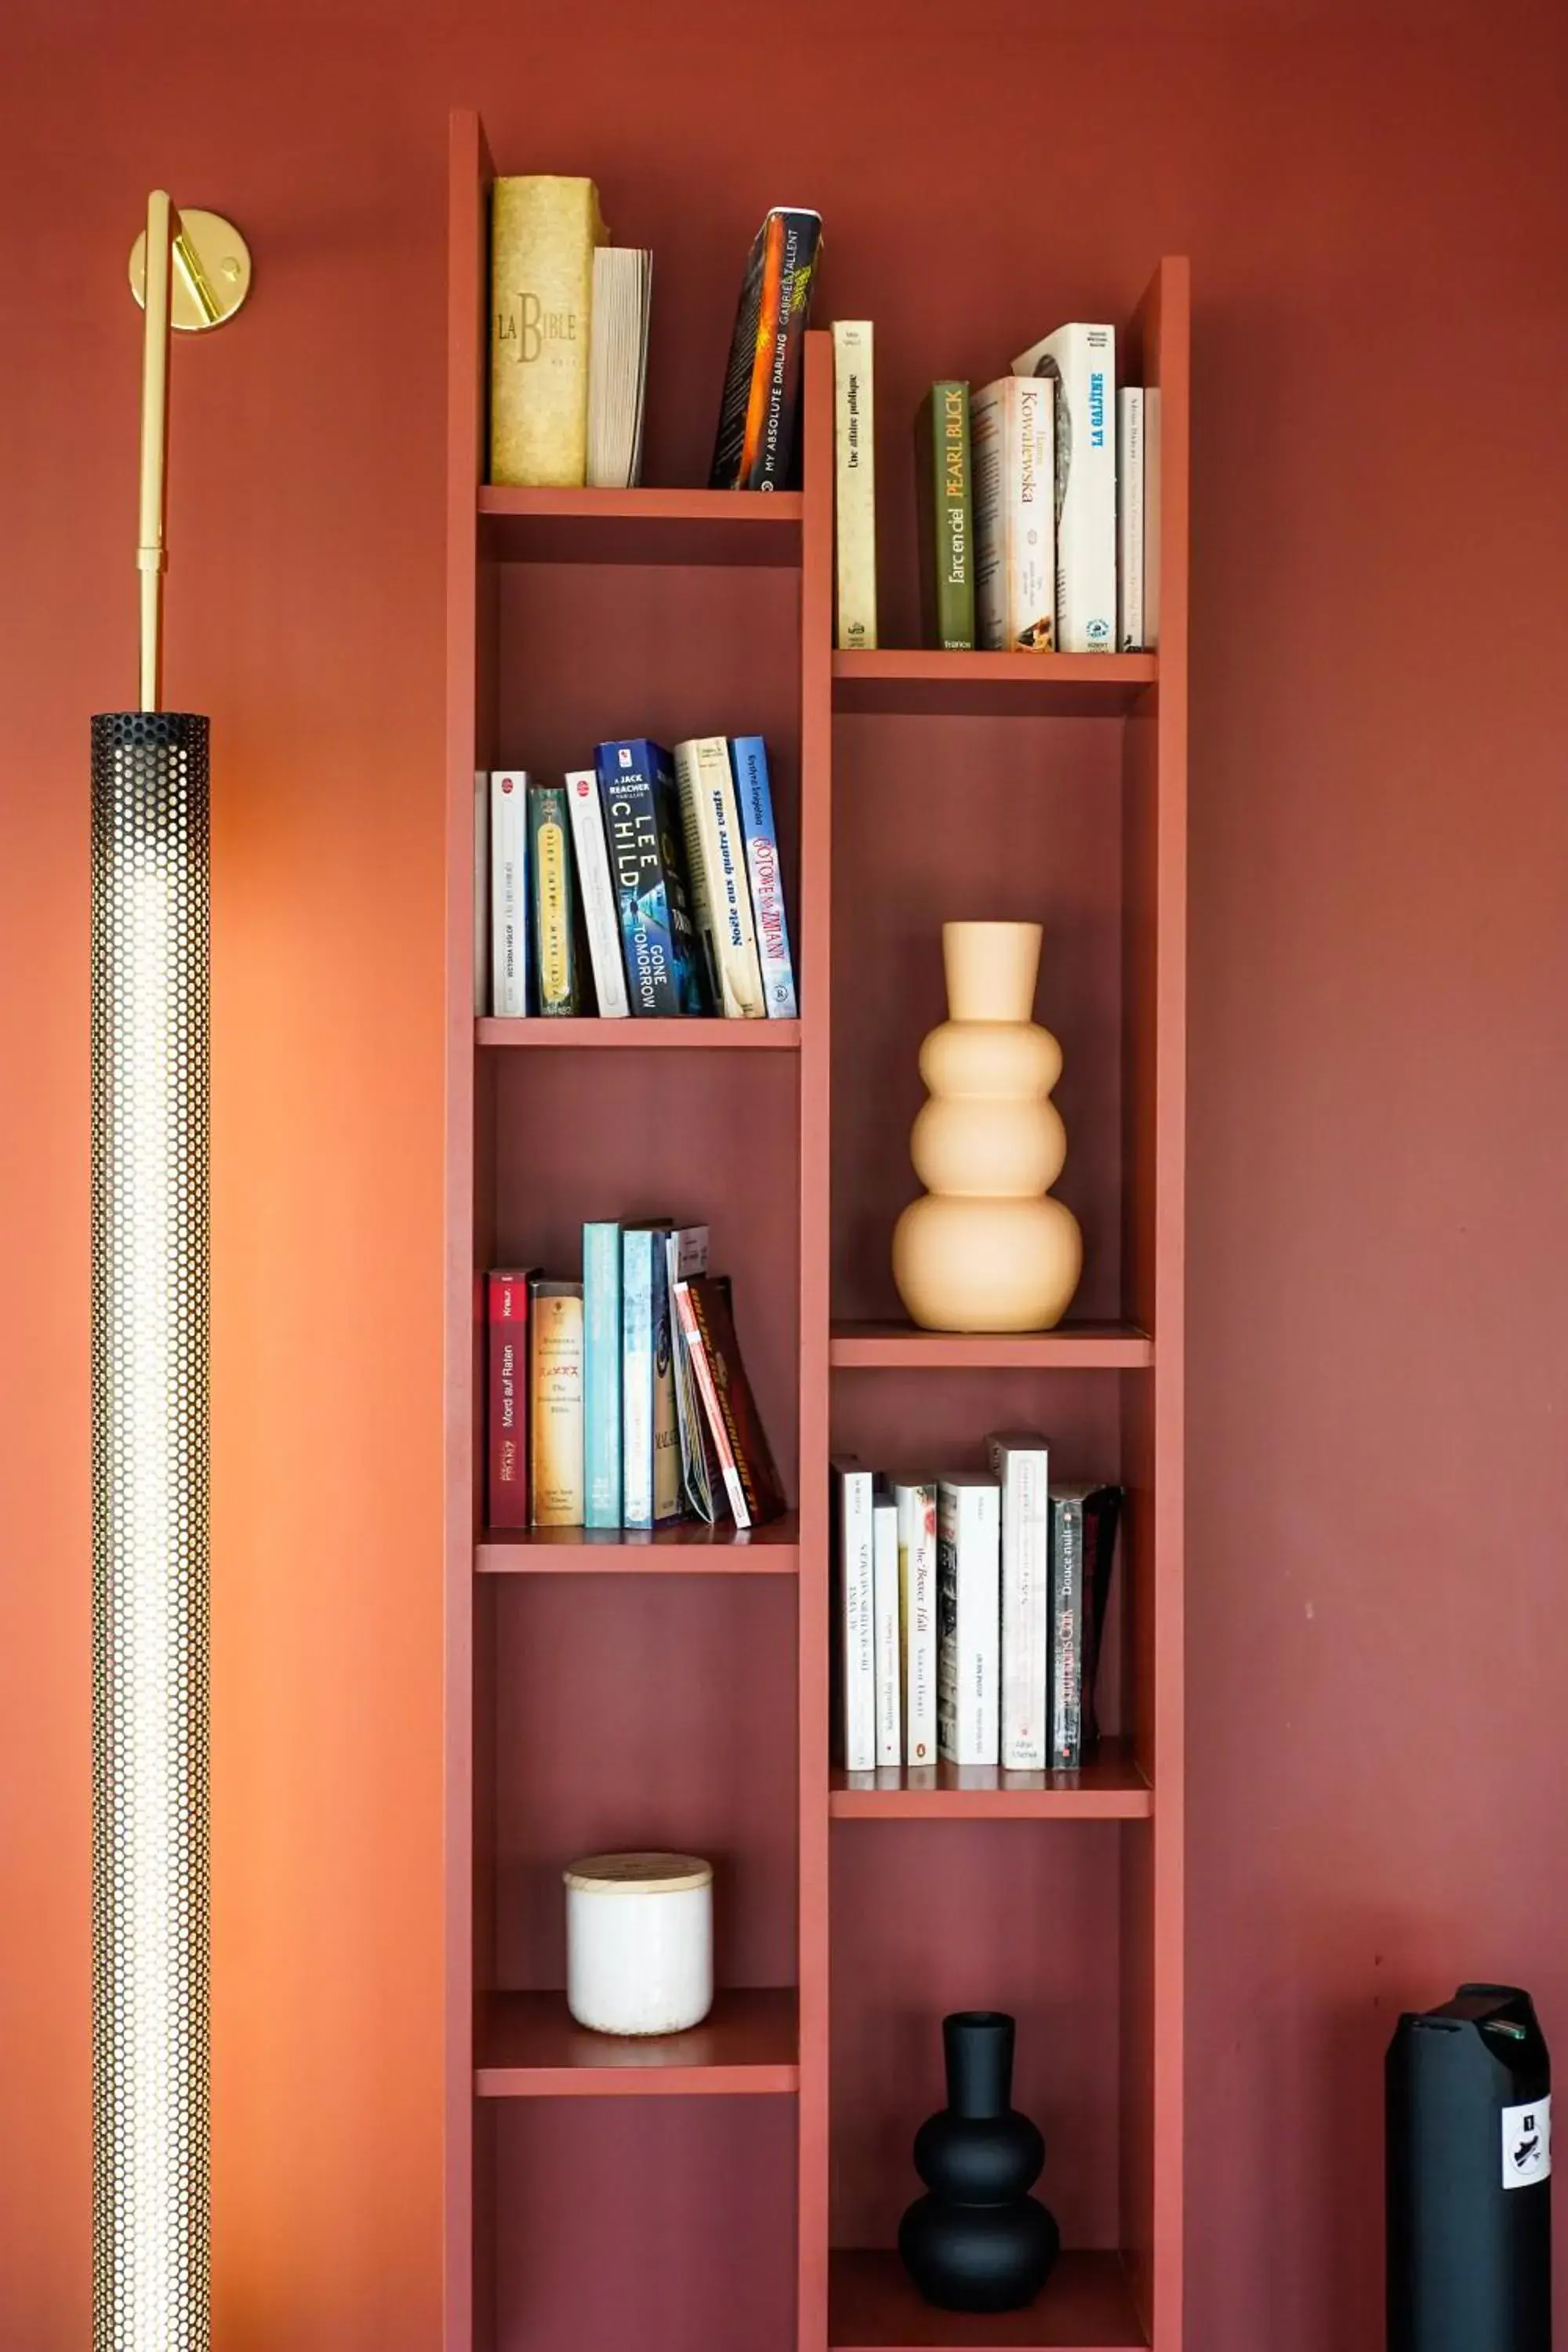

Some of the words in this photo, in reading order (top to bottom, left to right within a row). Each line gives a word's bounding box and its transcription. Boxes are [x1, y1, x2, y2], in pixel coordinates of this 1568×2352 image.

[784, 229, 798, 275] TALLENT
[779, 277, 793, 325] GABRIEL
[499, 313, 517, 339] LA
[517, 292, 577, 364] BIBLE
[773, 334, 787, 383] DARLING
[848, 374, 859, 415] publique
[946, 390, 963, 438] BUCK
[767, 388, 782, 451] ABSOLUTE
[848, 418, 858, 448] affaire
[1091, 430, 1103, 448] LA
[765, 454, 775, 471] MY
[848, 451, 858, 468] Une
[1022, 391, 1037, 503] Kowalewska
[946, 442, 964, 498] PEARL
[948, 508, 964, 532] ciel
[952, 533, 964, 552] en
[609, 783, 650, 794] REACHER
[620, 774, 644, 783] JACK
[713, 789, 724, 826] vents
[612, 802, 640, 887] CHILD
[635, 815, 658, 868] LEE
[719, 831, 734, 874] quatre
[753, 836, 775, 895] GOTOWE
[726, 879, 736, 904] aux
[761, 909, 785, 960] ZMIANY
[633, 924, 656, 1007] TOMORROW
[650, 945, 667, 985] GONE
[502, 1345, 514, 1377] Raten
[502, 1380, 514, 1397] auf
[502, 1399, 514, 1428] Mord
[1062, 1558, 1072, 1595] Douce
